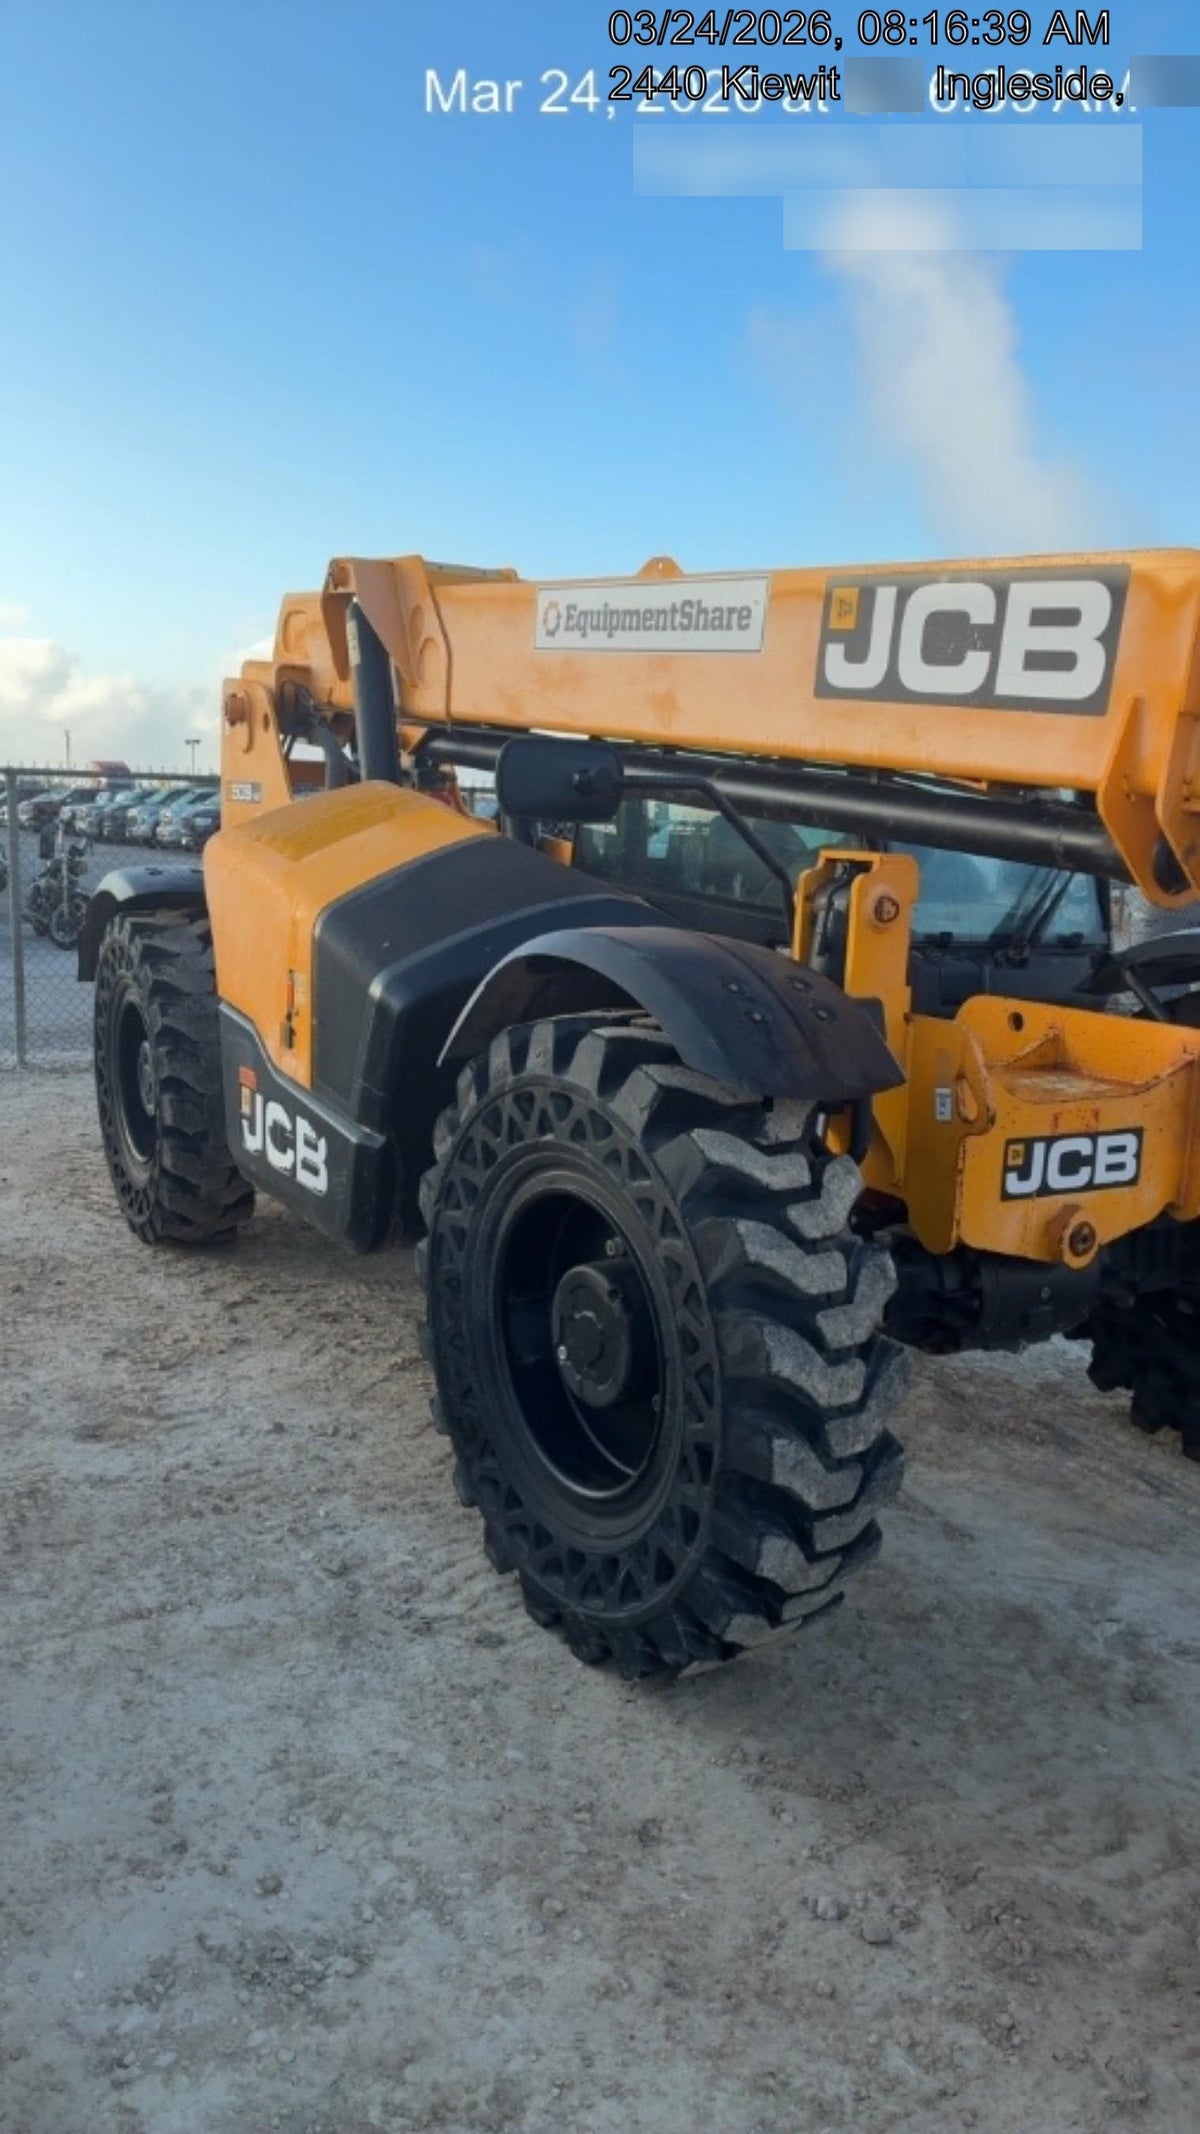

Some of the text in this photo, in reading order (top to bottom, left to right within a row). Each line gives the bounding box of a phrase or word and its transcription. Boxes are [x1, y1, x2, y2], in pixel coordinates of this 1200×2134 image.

[564, 599, 753, 638] EquipmentShare
[824, 580, 1112, 700] JCB
[241, 1092, 328, 1197] JCB
[1005, 1132, 1139, 1196] JCB
